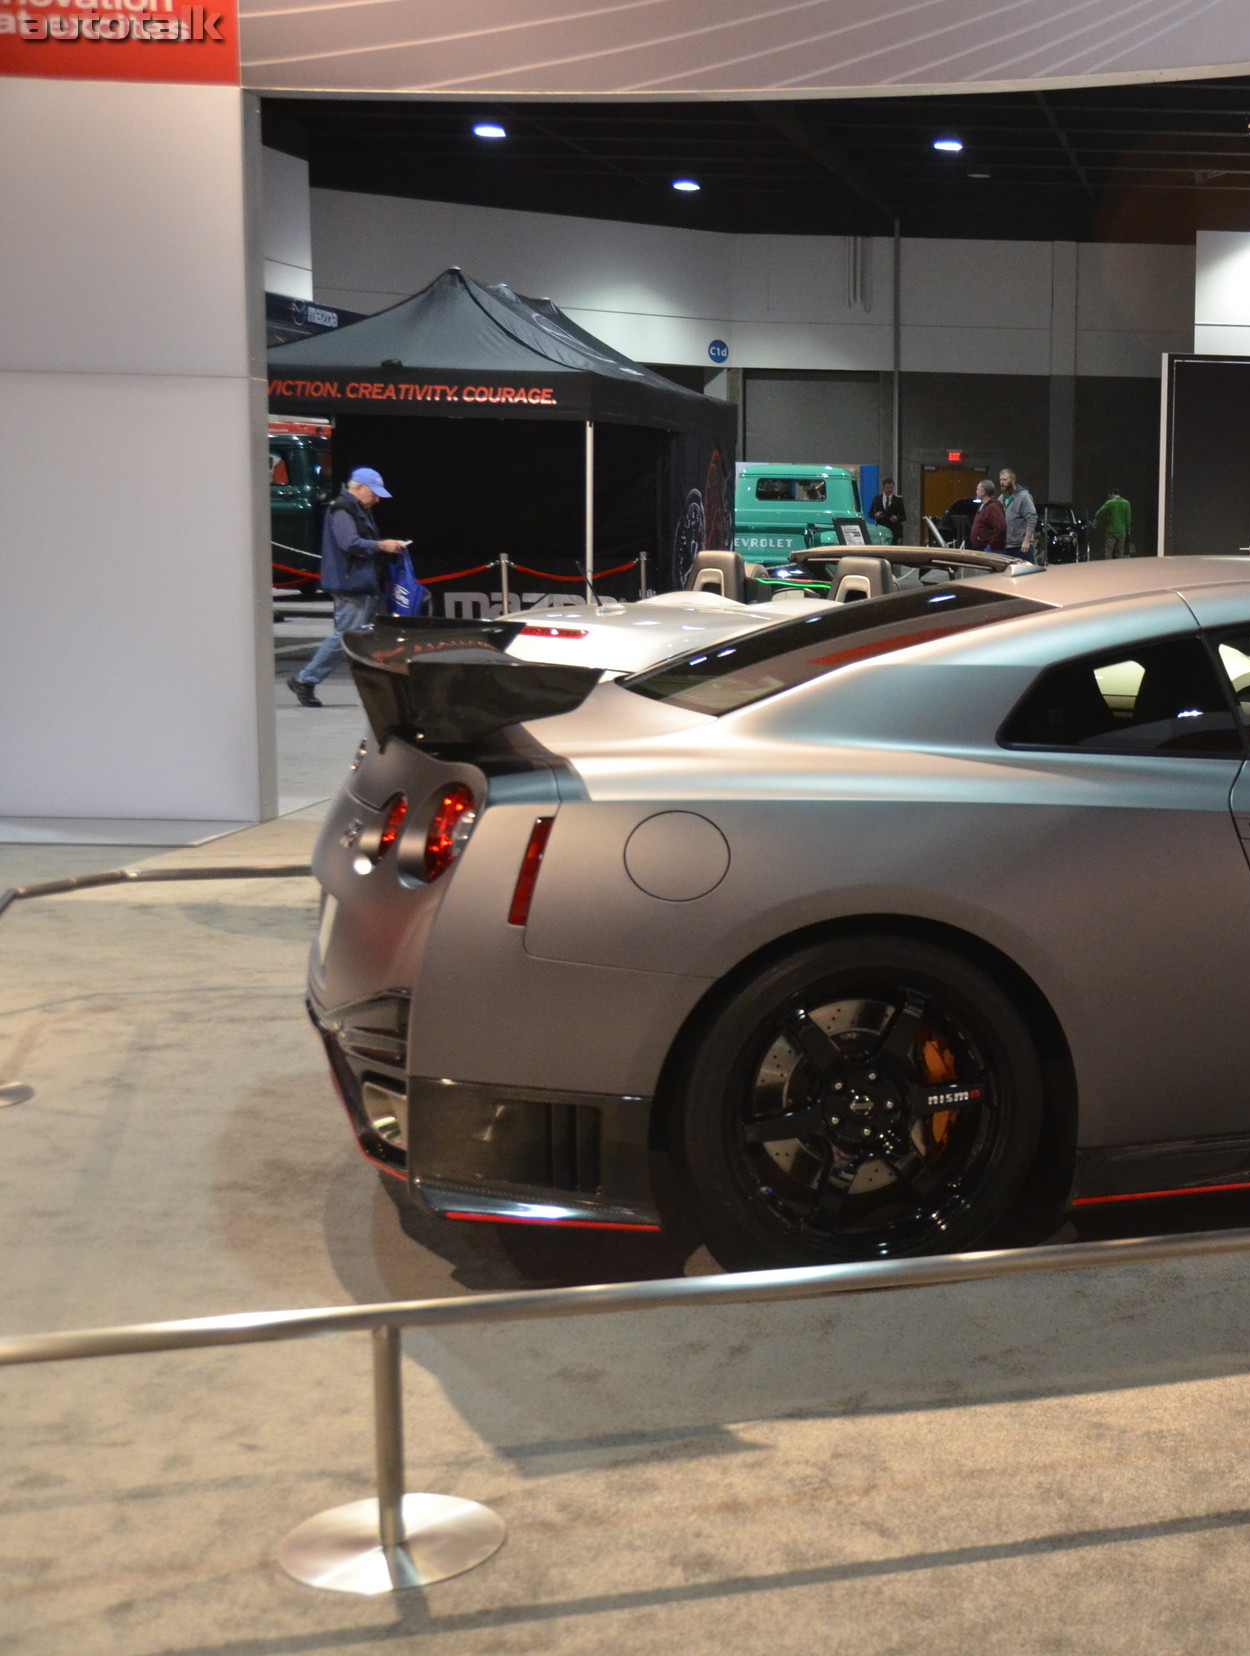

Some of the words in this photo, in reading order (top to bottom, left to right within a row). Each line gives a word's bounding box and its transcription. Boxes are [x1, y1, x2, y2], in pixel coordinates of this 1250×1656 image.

[710, 346, 728, 357] C1d
[346, 382, 459, 401] CREATIVITY.
[462, 386, 558, 405] COURAGE.
[444, 591, 617, 618] maz
